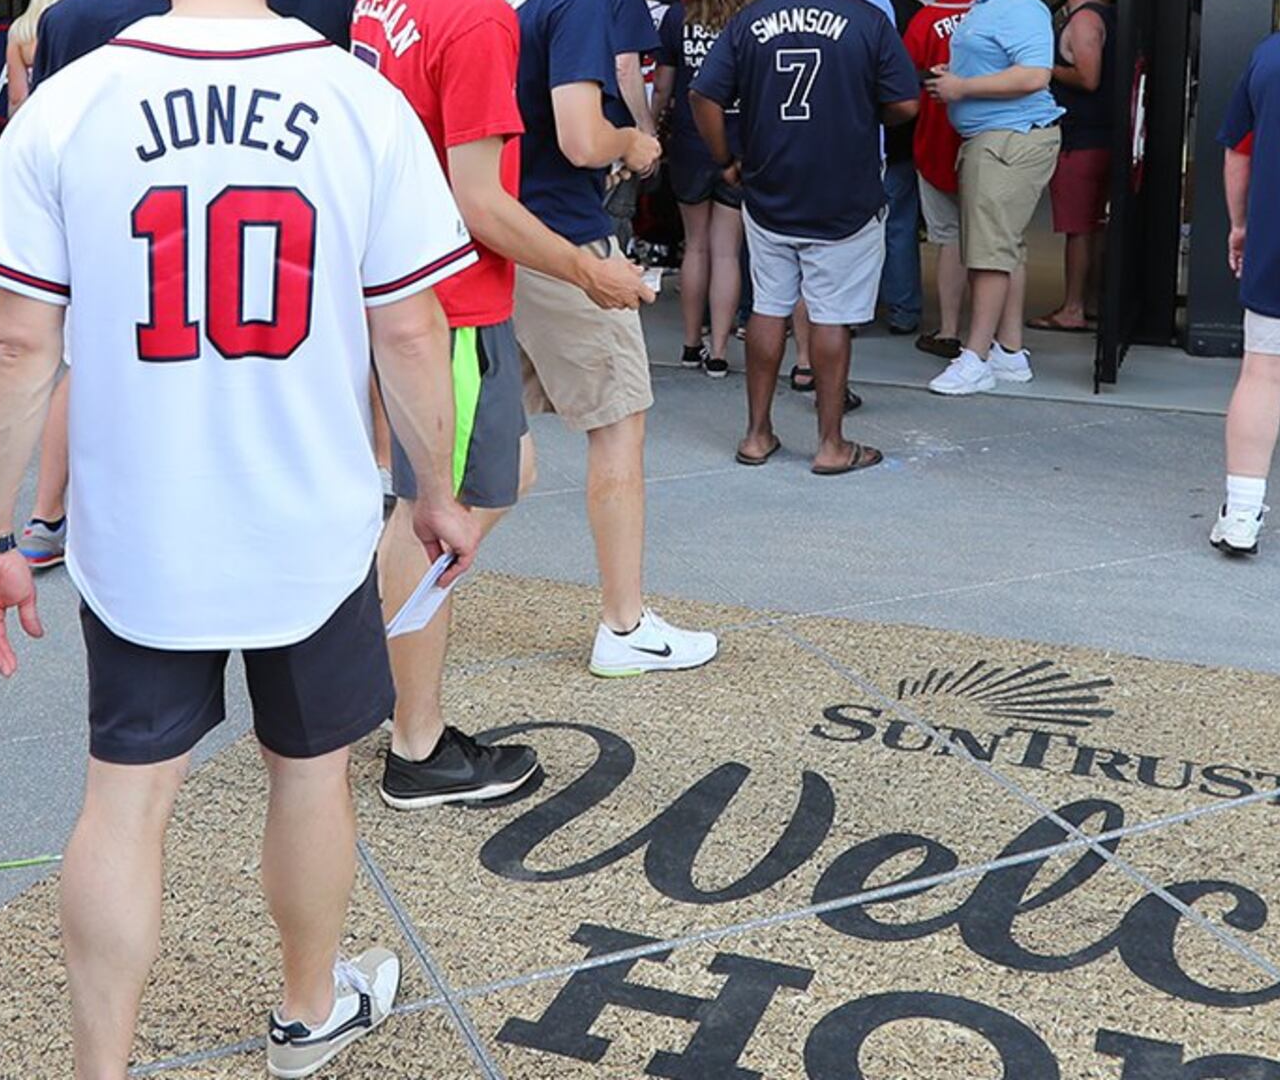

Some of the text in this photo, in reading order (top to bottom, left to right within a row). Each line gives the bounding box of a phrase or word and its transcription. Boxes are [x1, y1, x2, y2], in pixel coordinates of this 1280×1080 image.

[750, 8, 849, 44] SWANSON
[776, 48, 821, 120] 7
[136, 84, 320, 163] JONES
[130, 184, 318, 363] 10
